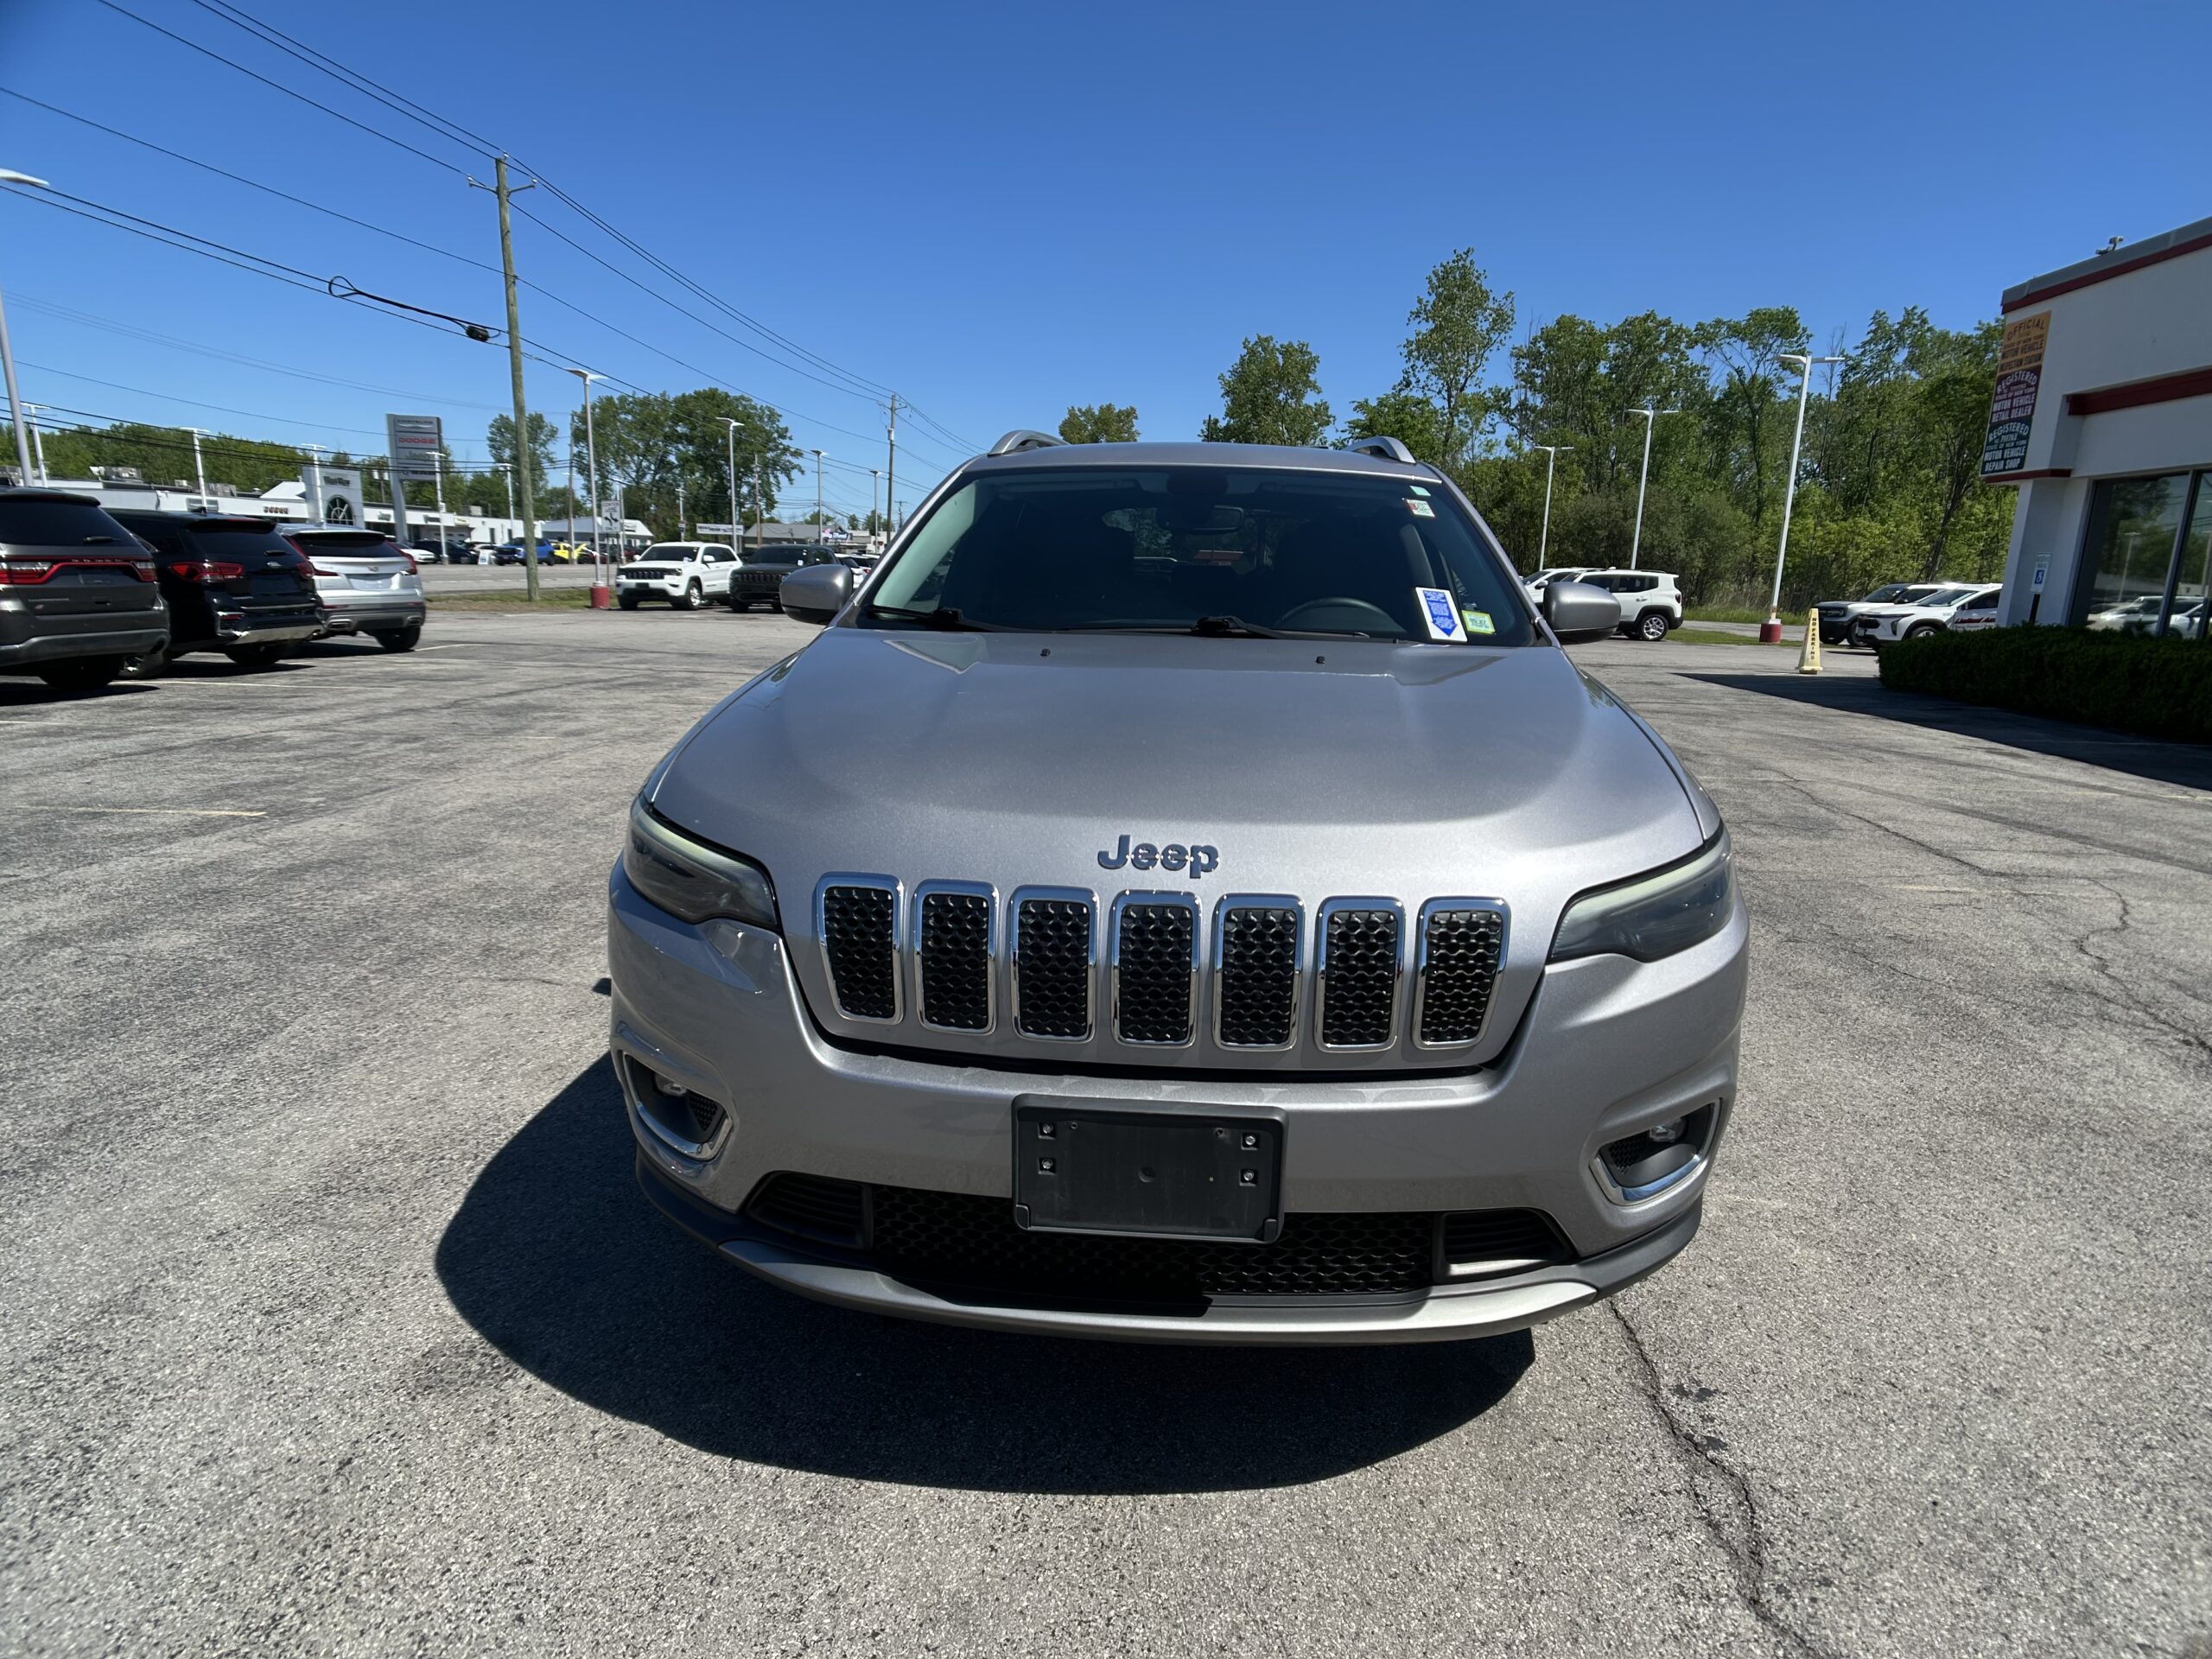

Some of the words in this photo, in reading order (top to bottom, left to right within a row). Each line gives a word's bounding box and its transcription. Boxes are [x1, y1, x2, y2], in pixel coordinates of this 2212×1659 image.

[2007, 317, 2045, 340] OFFICIAL
[2001, 347, 2019, 359] MOTOR
[2020, 339, 2044, 354] VEHICLE
[2024, 353, 2043, 366] STATION
[1997, 371, 2037, 394] REGISTERED
[1993, 398, 2012, 412] MOTOR
[2012, 392, 2036, 408] VEHICLE
[1991, 410, 2010, 423] RETAIL
[2011, 404, 2032, 419] DEALER
[1988, 423, 2030, 442] REGISTERED
[1984, 449, 2003, 461] MOTOR
[2004, 446, 2026, 459] VEHICLE
[1984, 460, 2005, 472] REPAIR
[2005, 458, 2021, 469] SHOP
[1811, 617, 1817, 626] NO
[1097, 834, 1220, 879] Jeep
